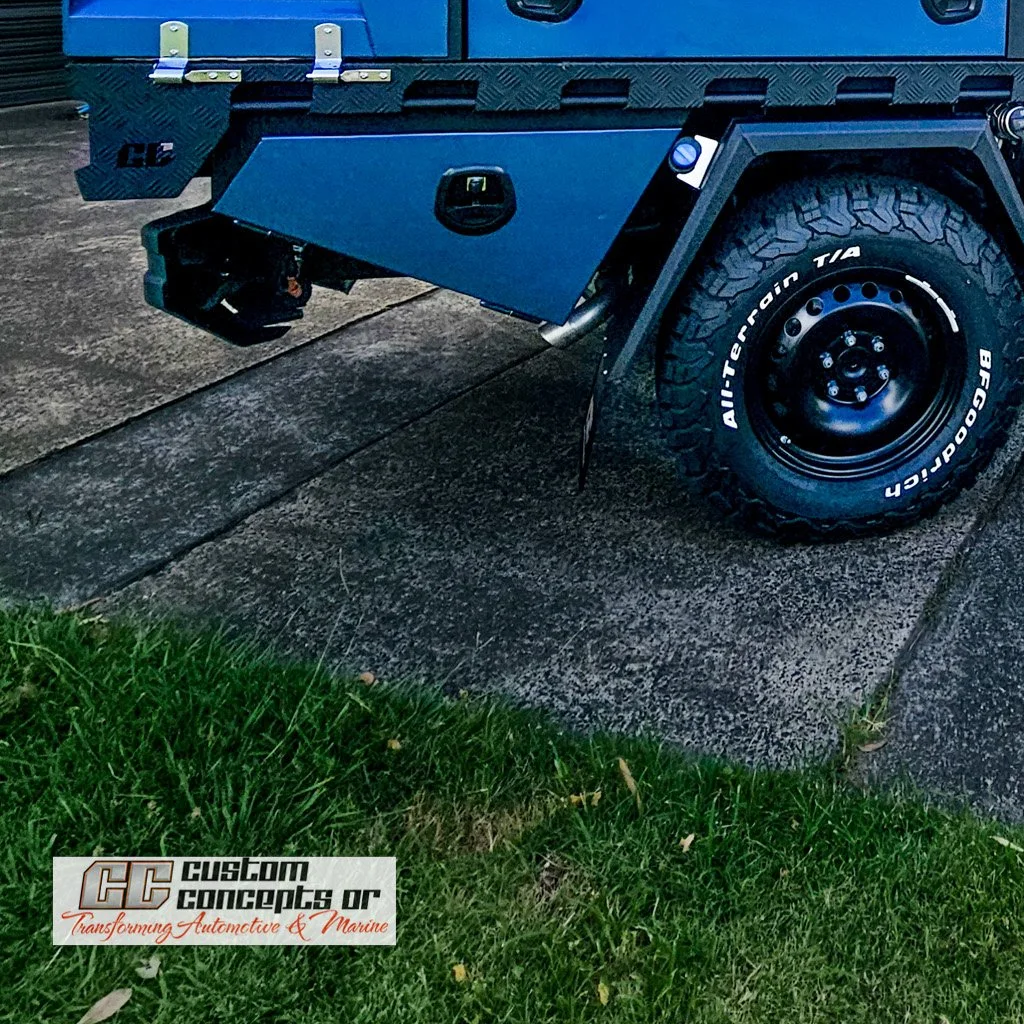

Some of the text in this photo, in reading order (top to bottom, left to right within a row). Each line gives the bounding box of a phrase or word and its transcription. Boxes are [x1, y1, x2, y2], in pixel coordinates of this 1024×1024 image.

[116, 141, 176, 168] CC
[720, 245, 861, 430] All-Terrain T/A
[884, 348, 992, 499] BFGoodrich
